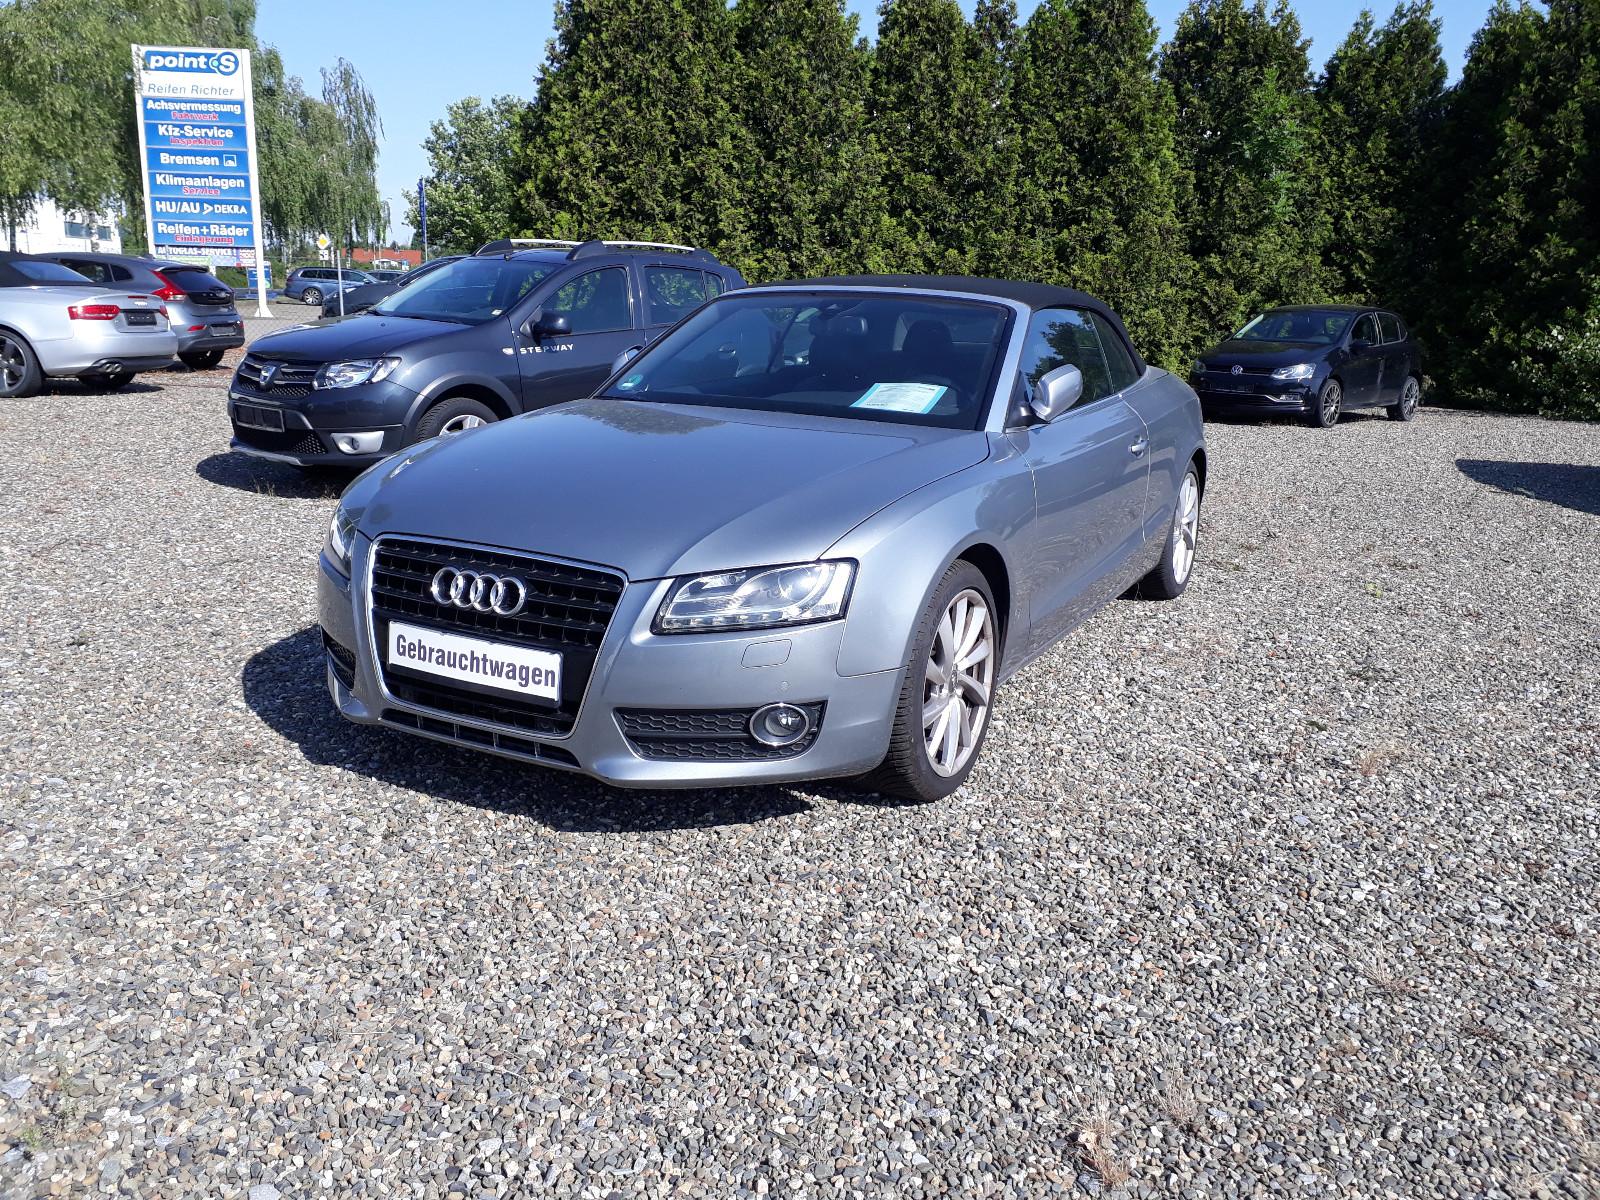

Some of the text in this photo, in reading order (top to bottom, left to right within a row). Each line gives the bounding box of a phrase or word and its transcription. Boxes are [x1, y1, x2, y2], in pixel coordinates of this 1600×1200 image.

[149, 53, 236, 72] point S
[148, 83, 235, 96] Reifen Richter
[147, 100, 241, 114] Achsvermessung
[158, 124, 233, 138] Kfz-Service
[160, 153, 219, 166] Bremsen
[155, 174, 245, 189] Klimaanlagen
[183, 187, 219, 195] Service
[155, 201, 248, 214] HU/AU DEKRA
[175, 234, 233, 244] Einlagerung
[520, 343, 574, 355] STEPWAY
[396, 634, 556, 688] Gebrauchtwagen
